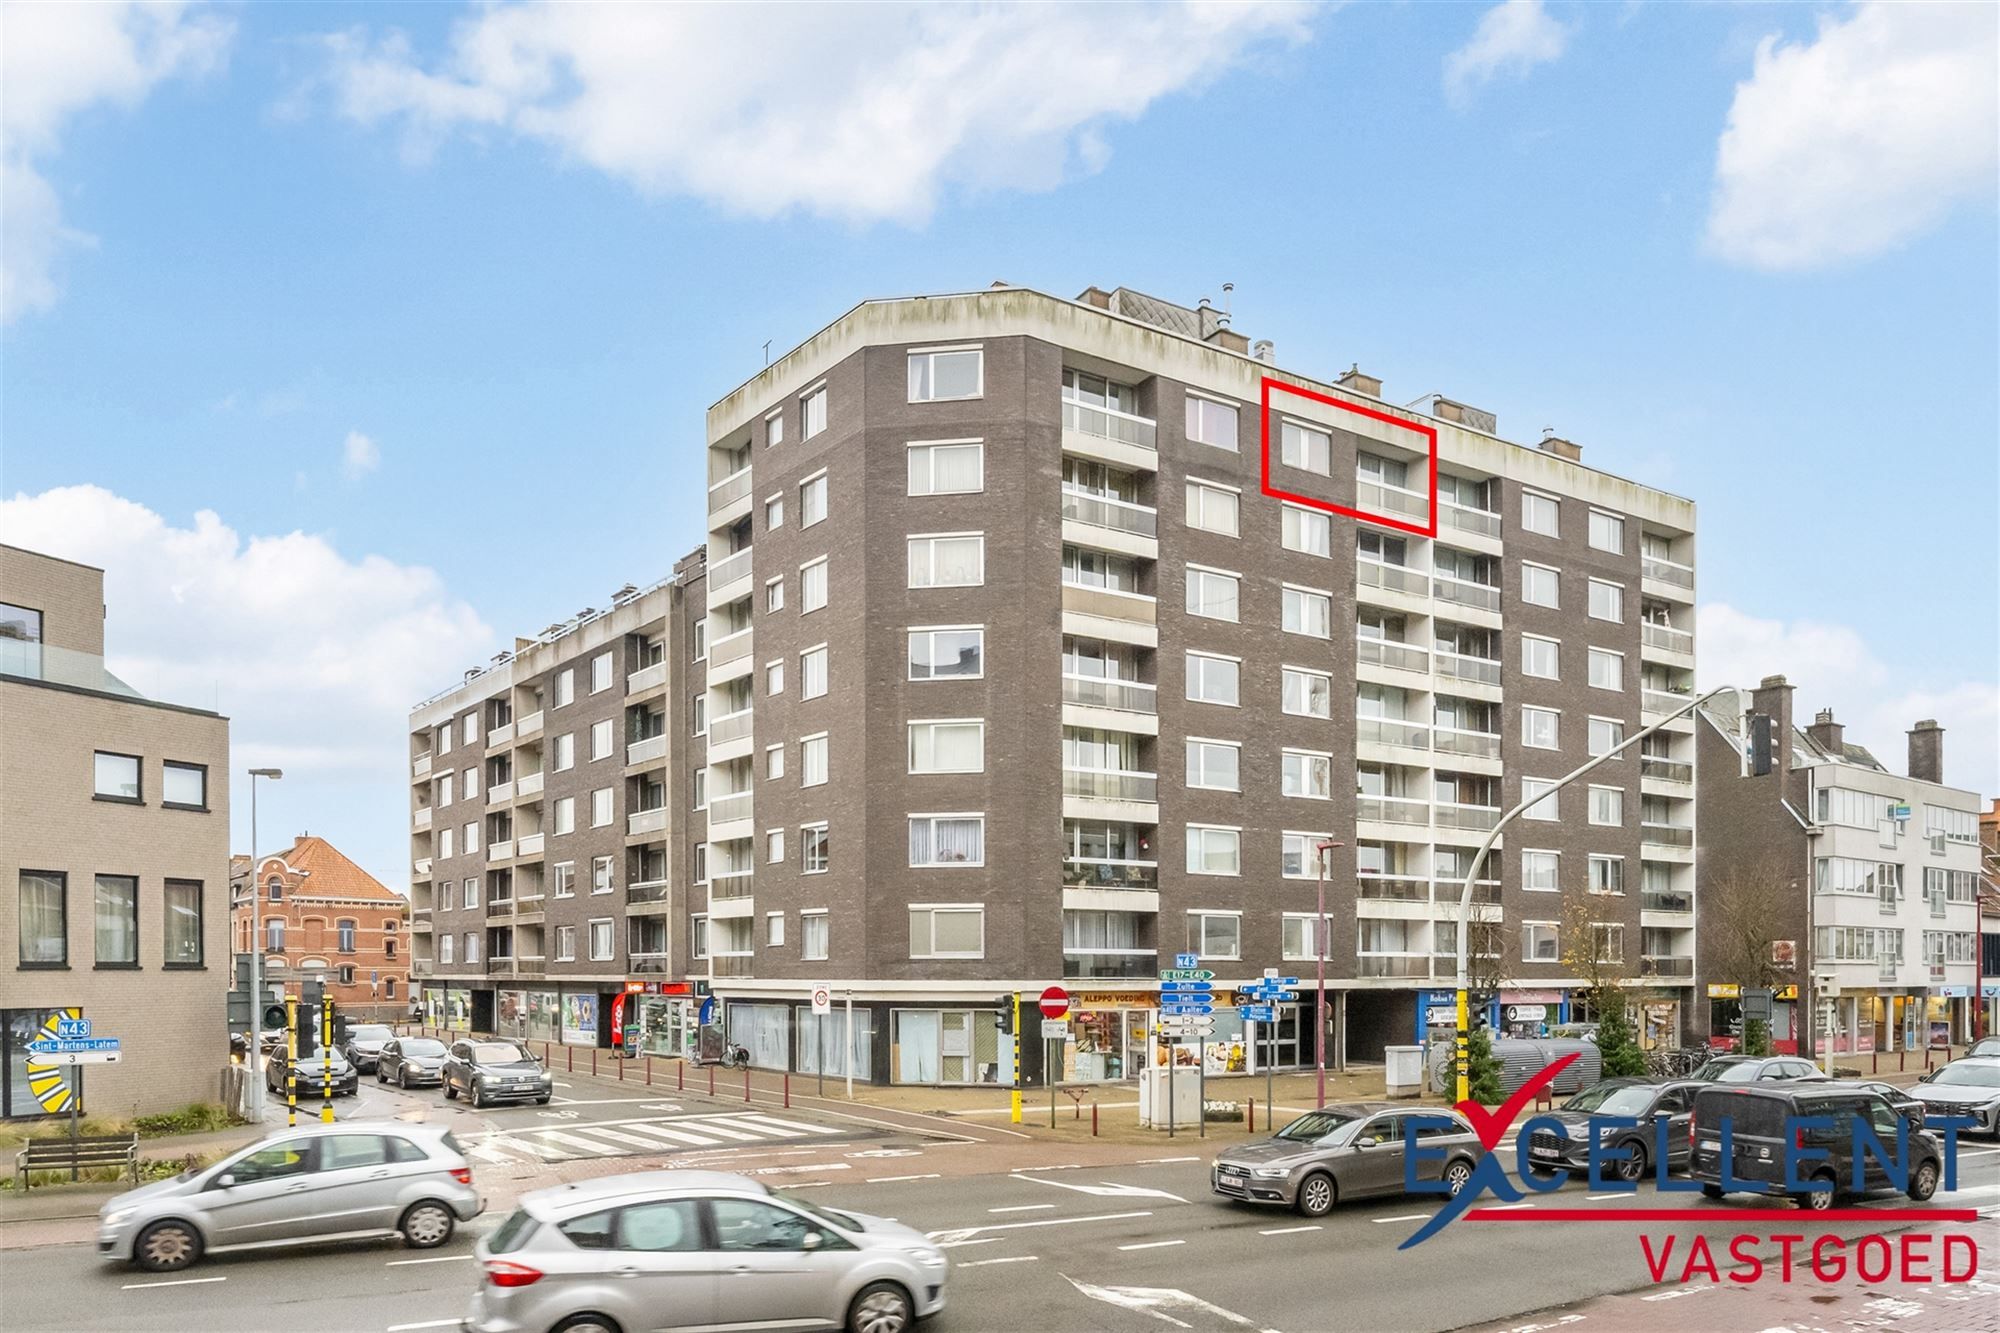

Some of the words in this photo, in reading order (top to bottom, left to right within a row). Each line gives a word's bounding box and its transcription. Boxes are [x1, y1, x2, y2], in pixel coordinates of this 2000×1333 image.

[1177, 957, 1197, 967] N43
[1084, 994, 1112, 1002] ALEPPO
[1114, 994, 1145, 1002] VOEDING
[61, 1022, 87, 1035] N43
[35, 1041, 118, 1050] Sint-Martens-Latem
[69, 1055, 76, 1063] 3
